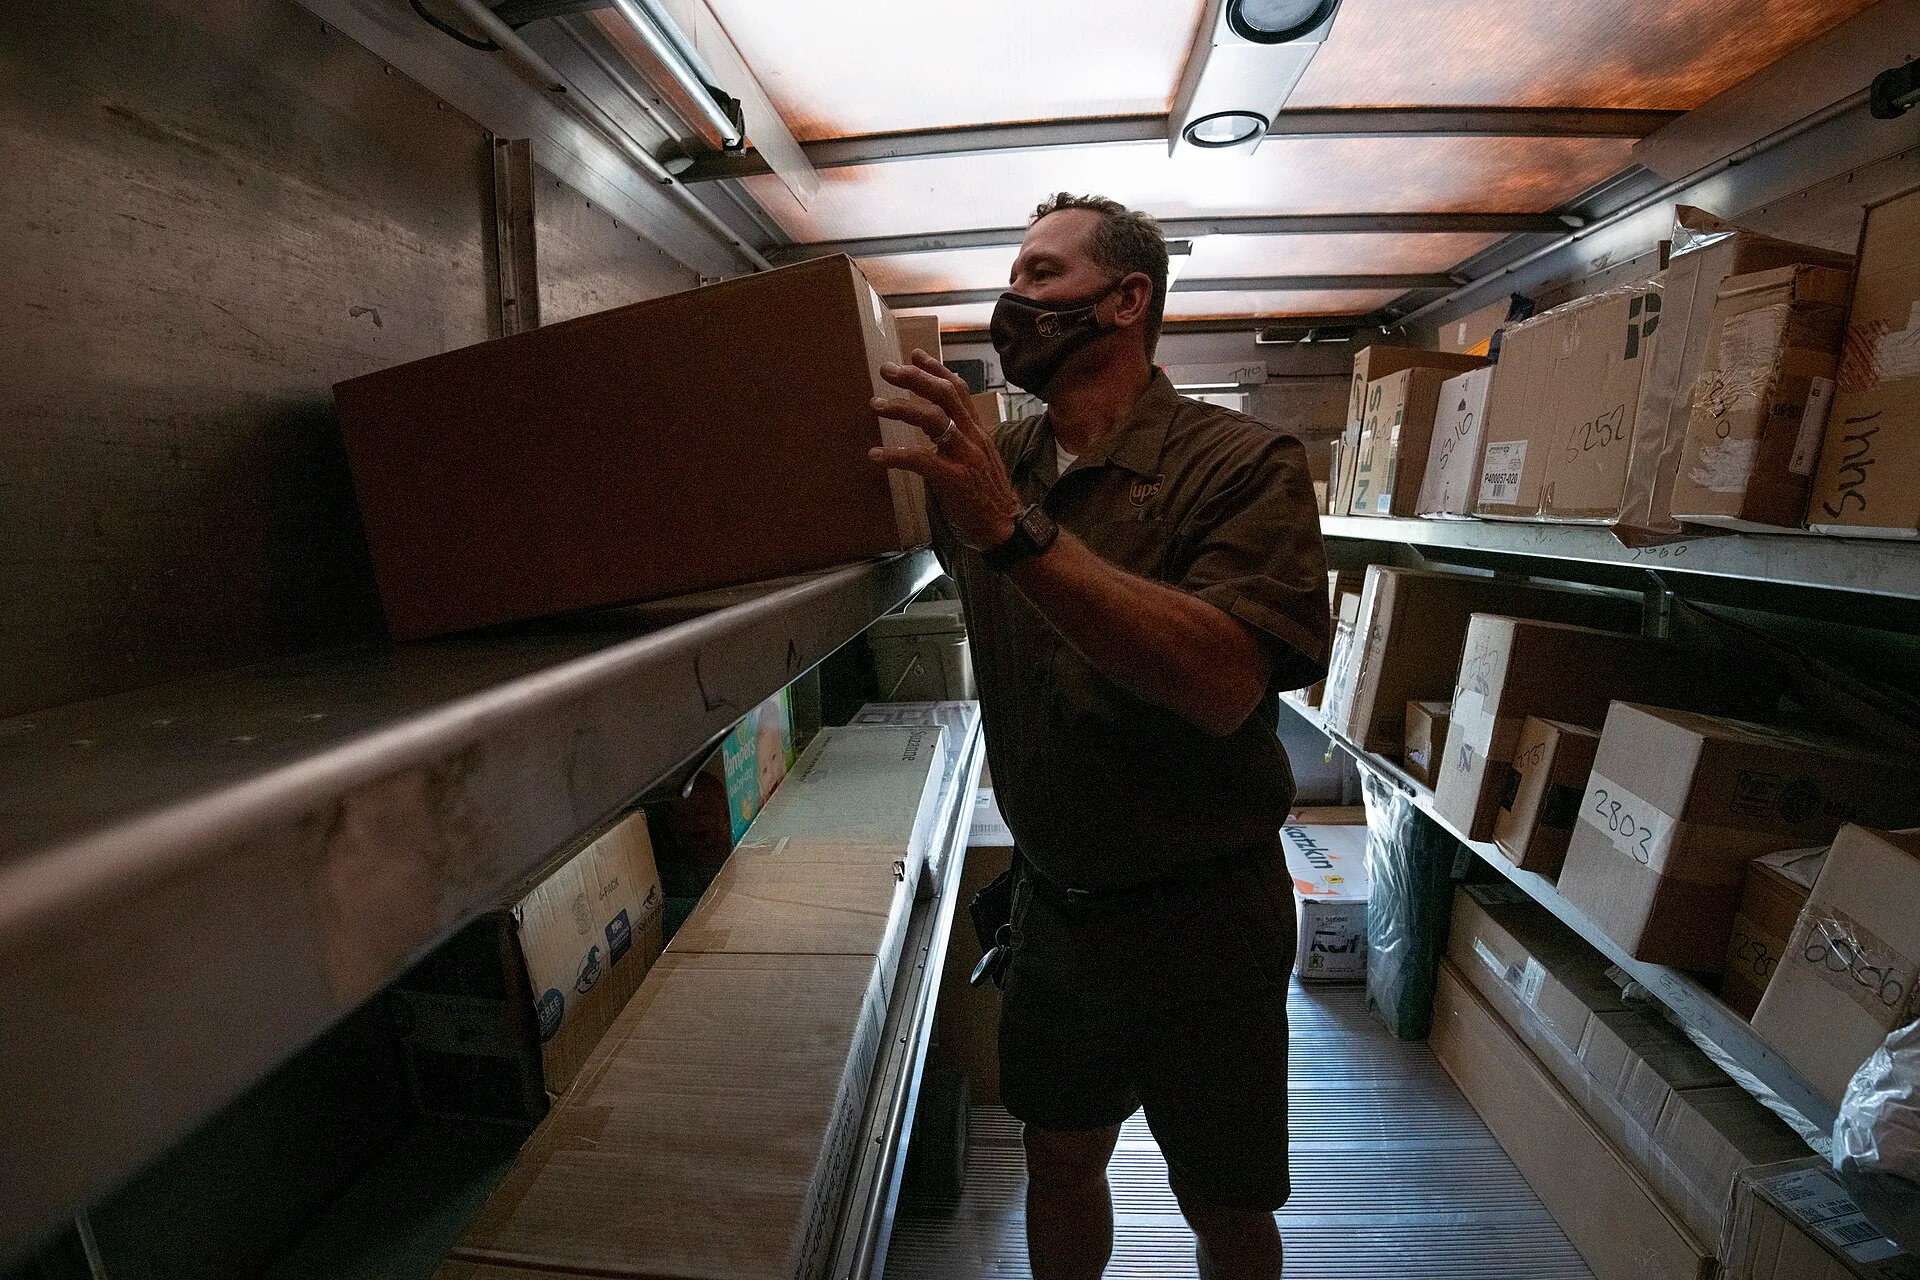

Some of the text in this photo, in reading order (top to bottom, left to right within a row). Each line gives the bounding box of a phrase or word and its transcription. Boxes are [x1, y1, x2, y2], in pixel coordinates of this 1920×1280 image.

[1038, 317, 1059, 334] ups
[1566, 404, 1625, 463] 5252
[1132, 482, 1161, 502] ups
[724, 736, 756, 778] Pampers
[1595, 789, 1653, 864] 2803
[539, 995, 562, 1023] FREE
